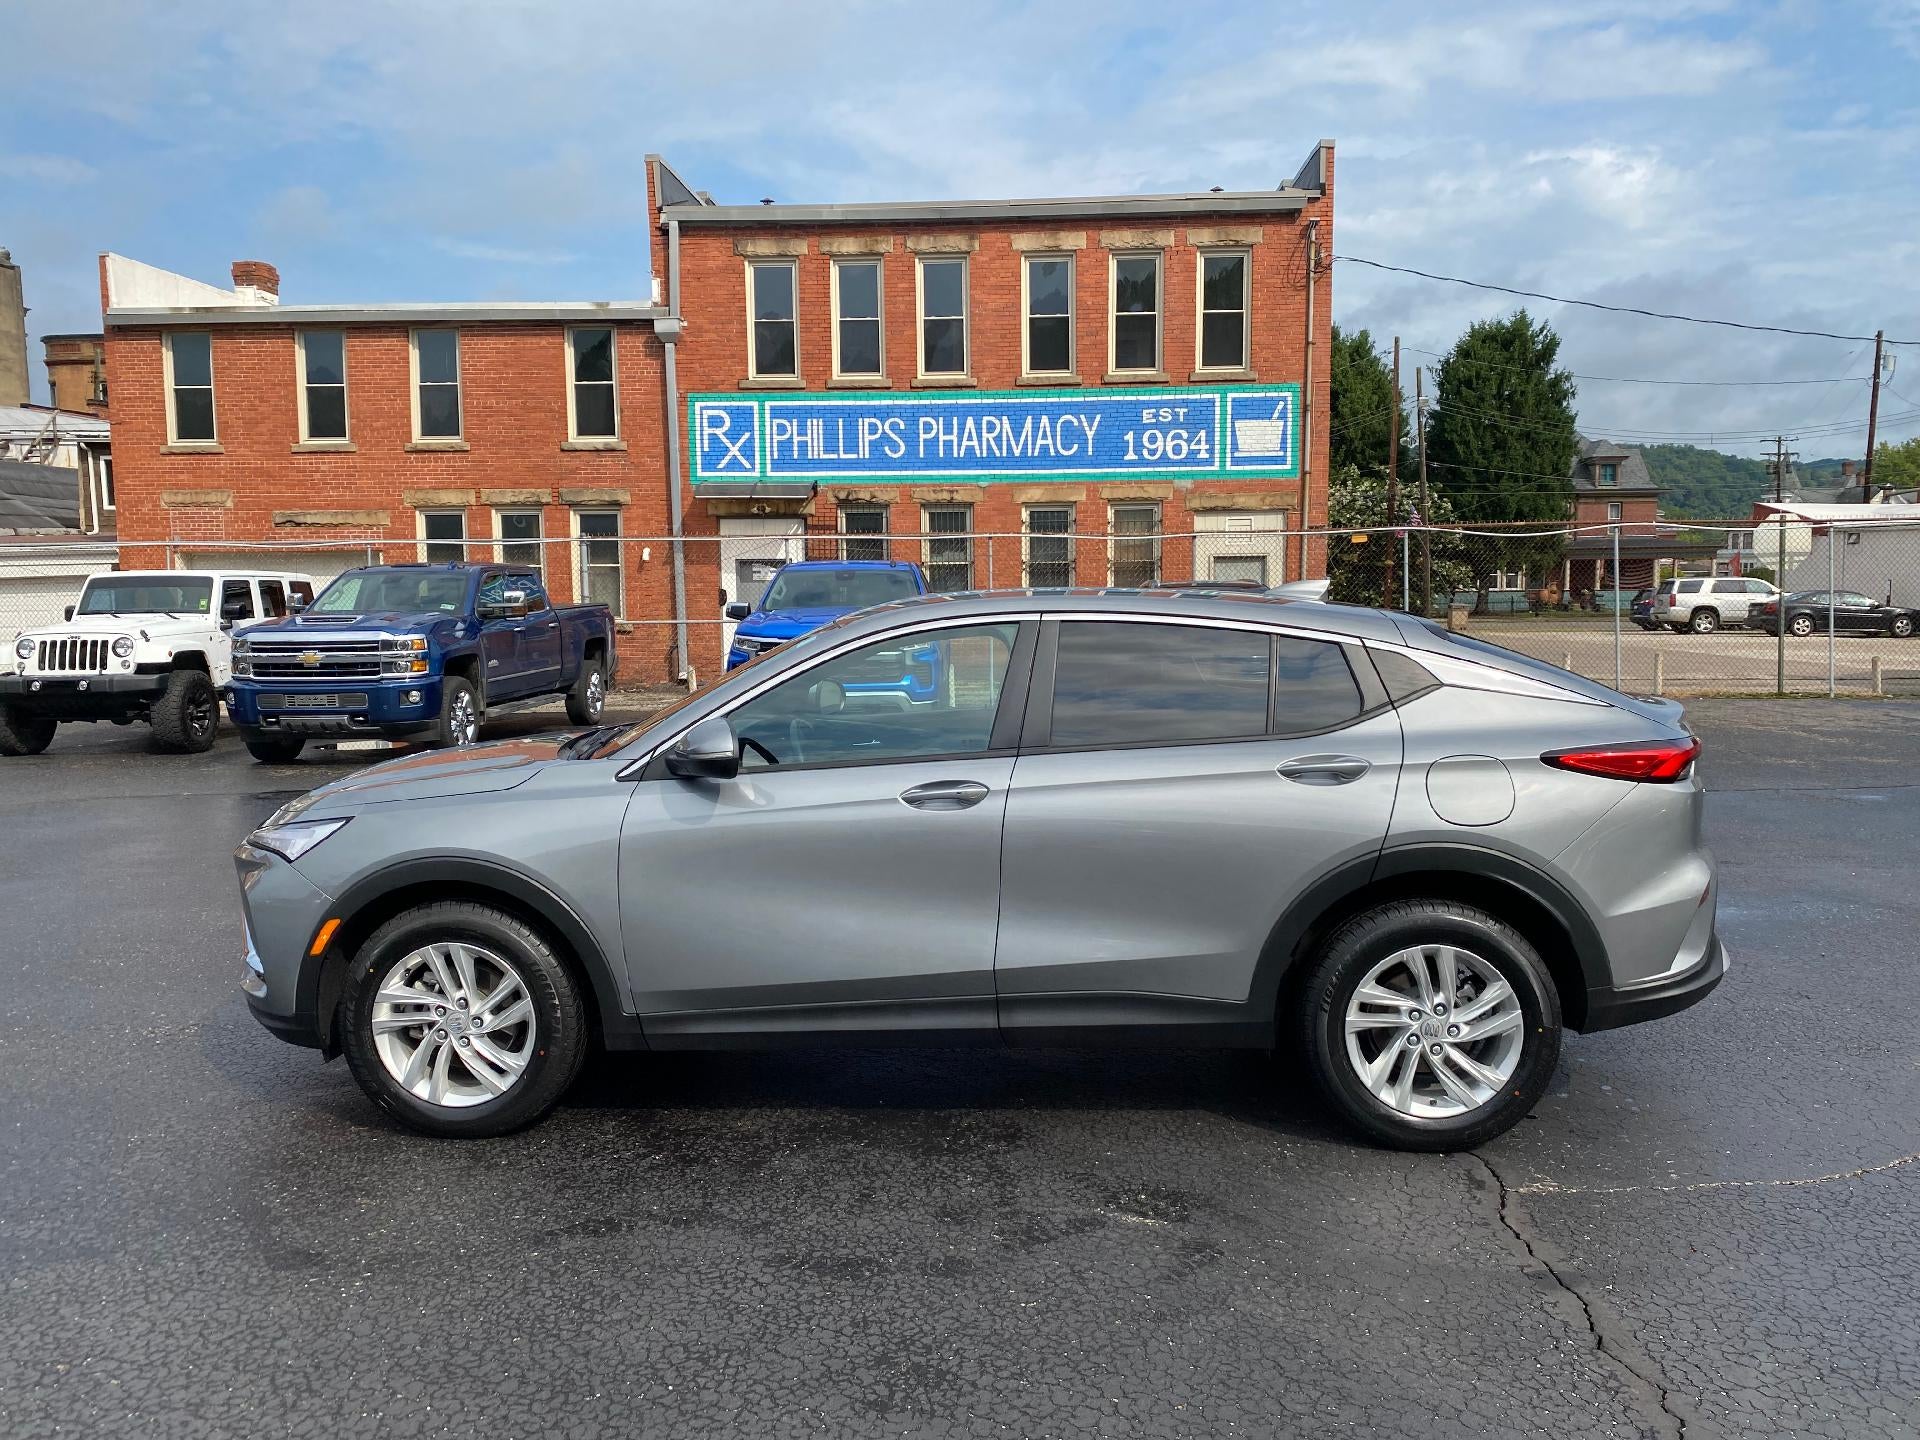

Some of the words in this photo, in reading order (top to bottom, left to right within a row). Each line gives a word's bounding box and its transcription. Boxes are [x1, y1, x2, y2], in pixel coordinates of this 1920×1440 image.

[1142, 408, 1189, 423] EST
[772, 417, 906, 459] PHILLIPS
[918, 414, 1102, 458] PHARMACY
[1123, 429, 1210, 460] 1964
